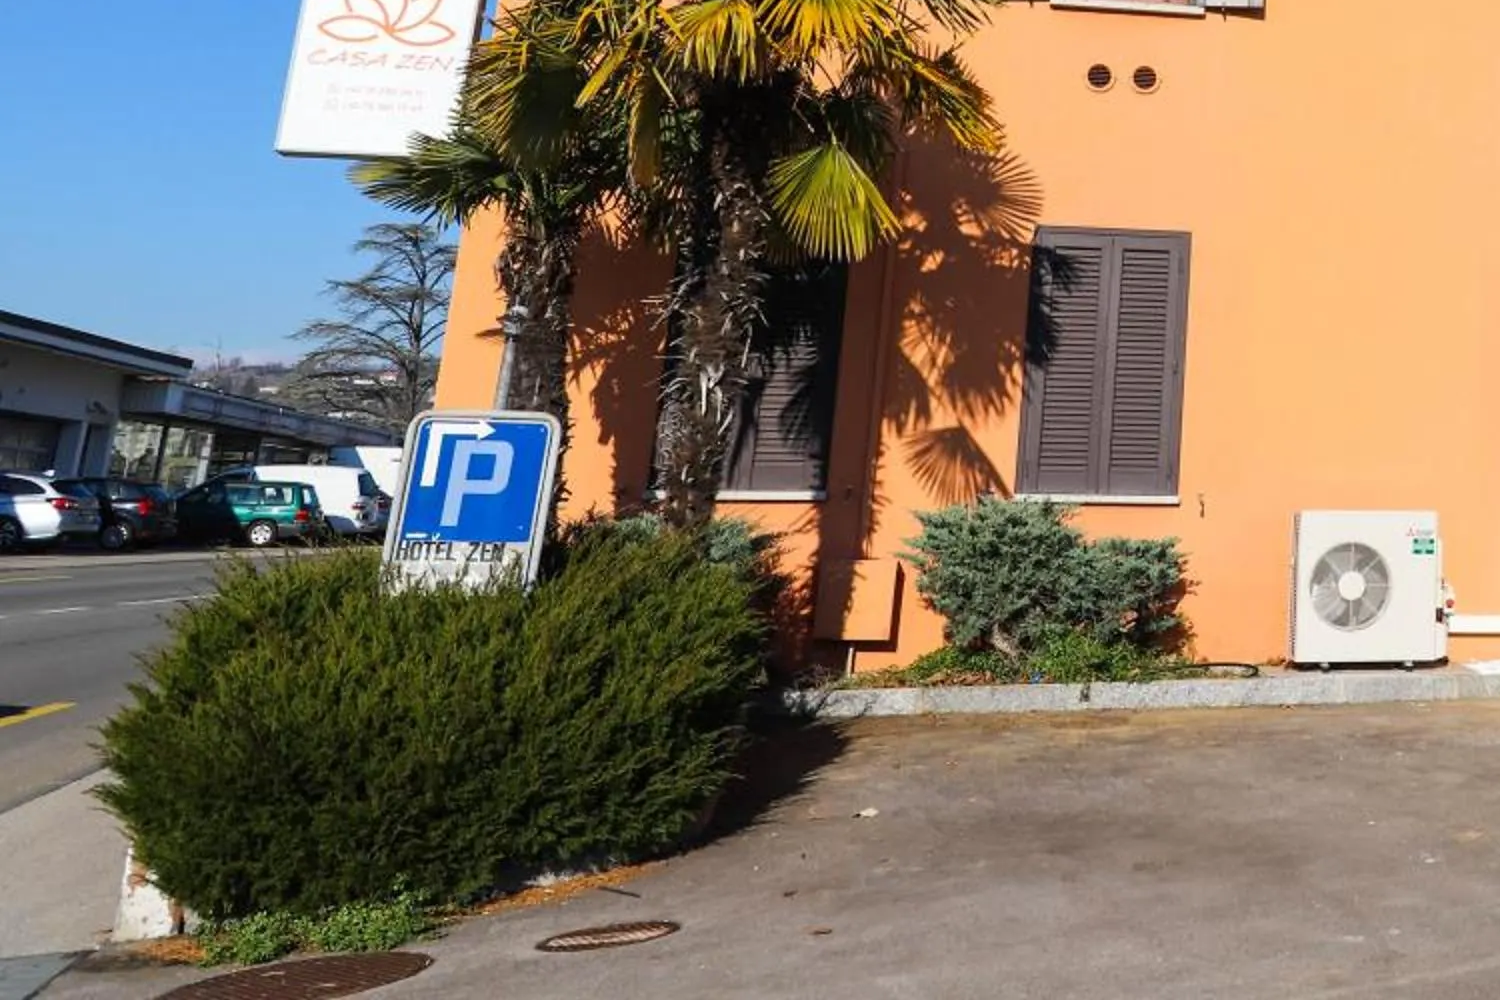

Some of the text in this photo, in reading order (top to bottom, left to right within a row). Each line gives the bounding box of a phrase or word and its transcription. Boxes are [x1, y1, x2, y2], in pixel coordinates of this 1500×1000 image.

[307, 48, 455, 72] CASA ZEN
[440, 439, 515, 527] P
[395, 540, 506, 563] HOTEL ZEN
